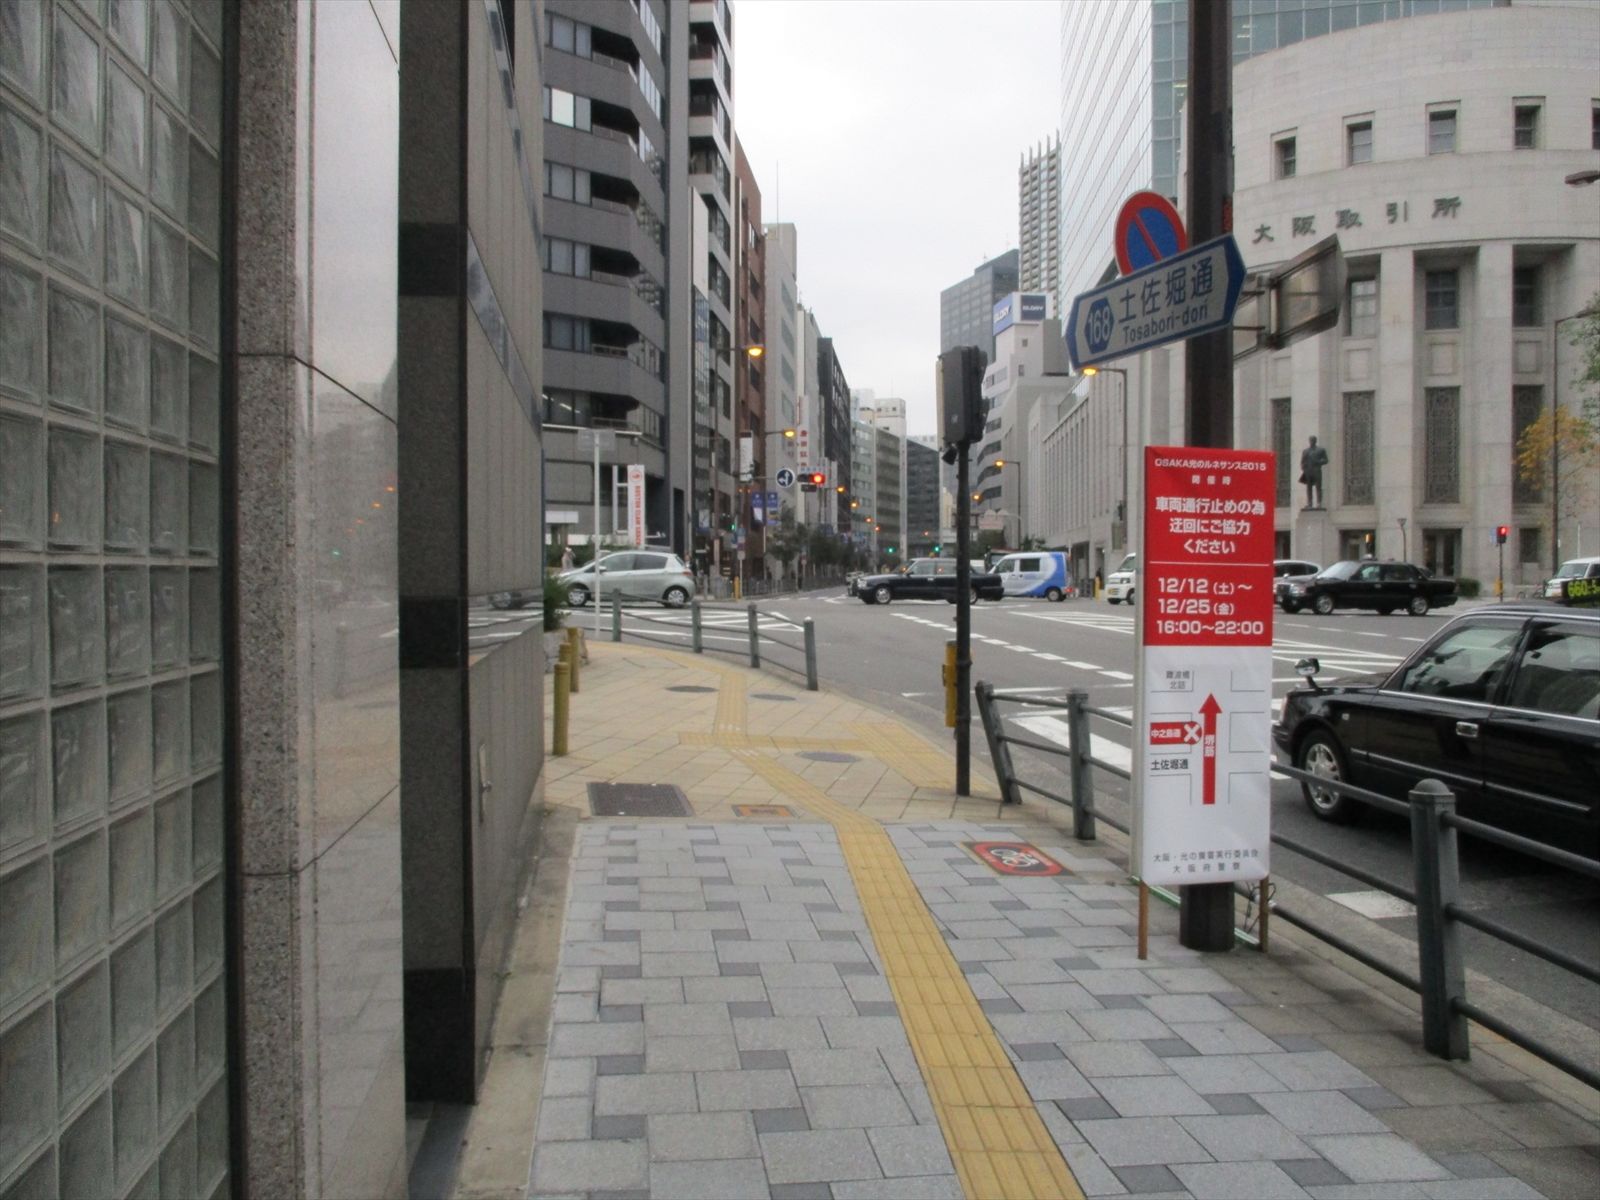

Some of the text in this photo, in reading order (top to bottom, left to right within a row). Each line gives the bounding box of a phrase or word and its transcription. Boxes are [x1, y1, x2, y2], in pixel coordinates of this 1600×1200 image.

[1252, 196, 1461, 244] 大阪取引所
[1118, 255, 1213, 324] 土佐堀通
[1087, 307, 1111, 346] 168
[1122, 302, 1208, 345] Tosabori-dori
[1155, 496, 1266, 515] 車両通行止めの為
[1169, 517, 1250, 535] 迂回にご協力
[1184, 539, 1236, 554] ください
[1151, 759, 1189, 771] 土佐堀通
